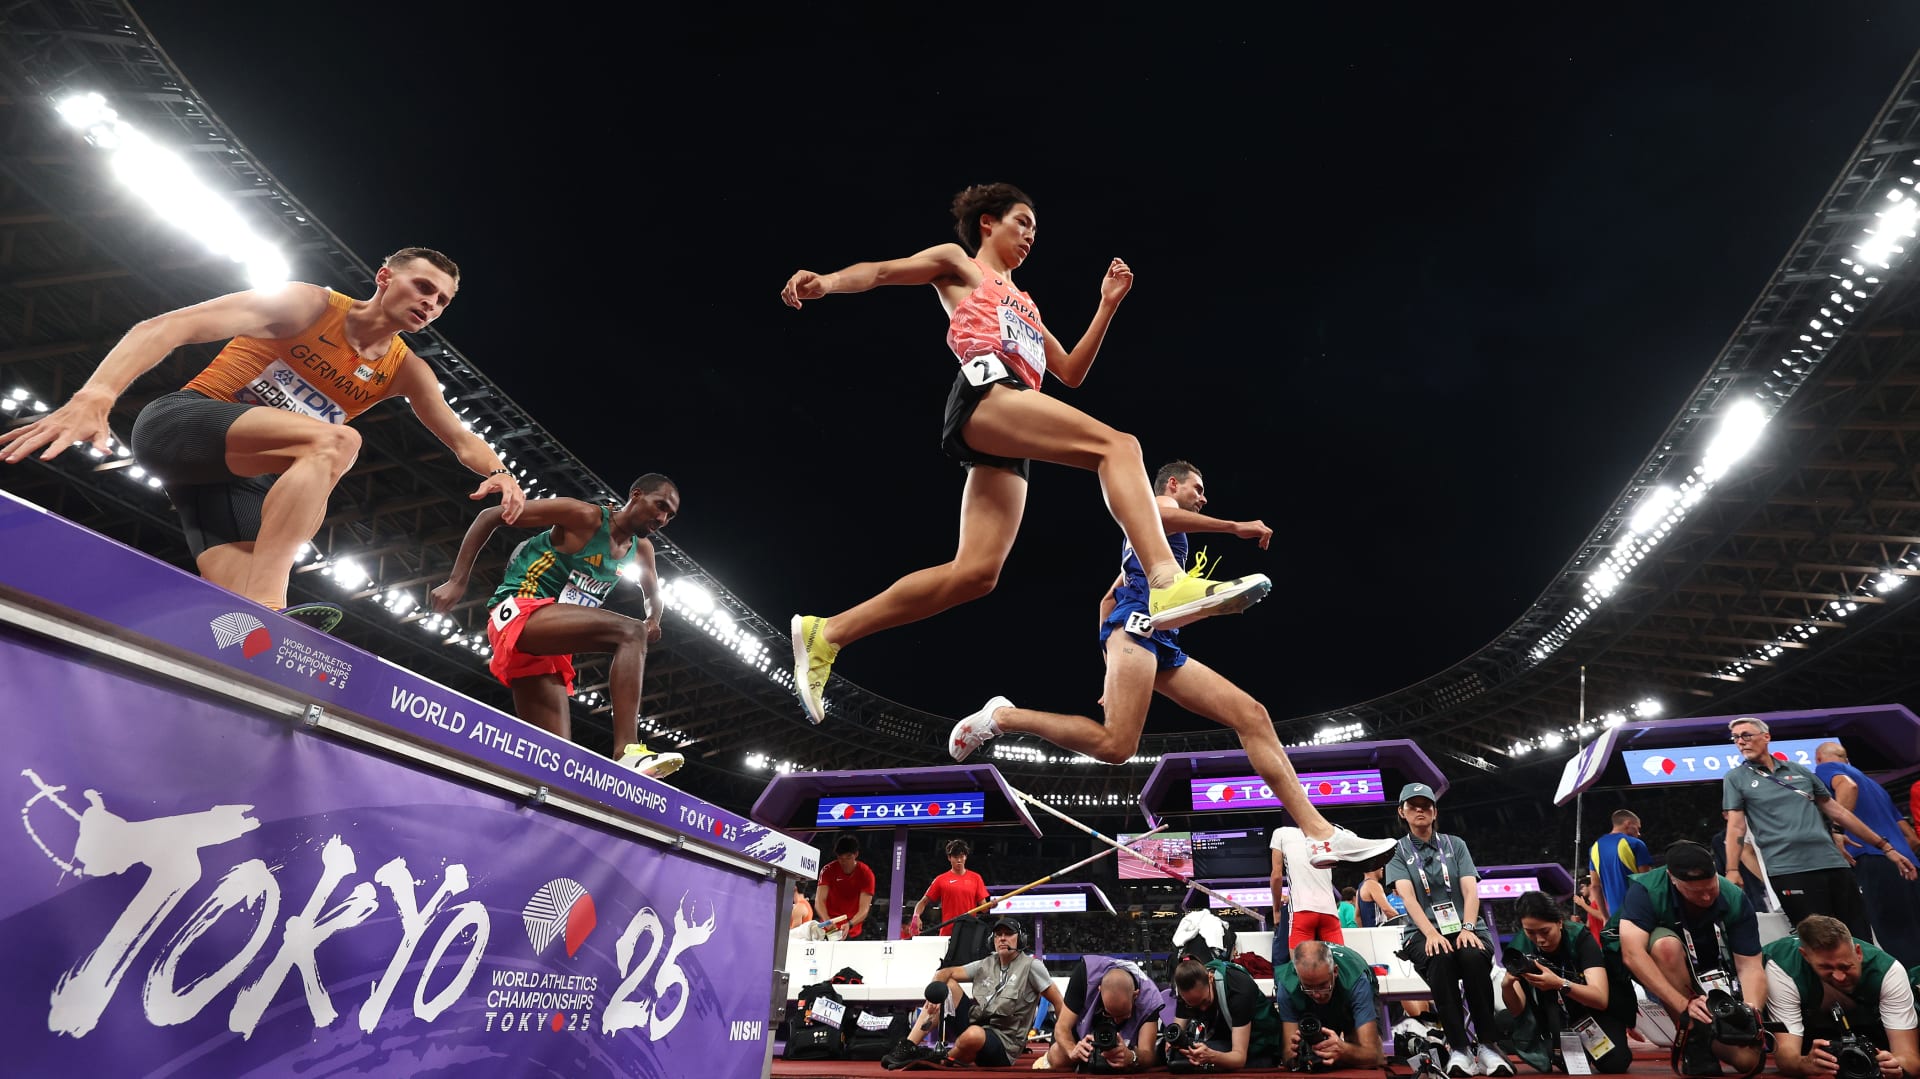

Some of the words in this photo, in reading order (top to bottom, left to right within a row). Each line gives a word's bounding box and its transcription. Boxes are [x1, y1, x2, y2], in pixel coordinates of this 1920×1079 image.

[1017, 319, 1044, 344] TDK
[290, 344, 376, 404] GERMANY
[973, 360, 997, 382] 2
[292, 378, 343, 425] TDK
[578, 592, 600, 608] TD
[500, 604, 512, 621] 6
[278, 646, 349, 680] CHAMPIONSHIPS
[283, 637, 311, 654] WORLD
[312, 651, 352, 672] ATHLETICS
[329, 677, 346, 689] 25
[390, 686, 466, 734] WORLD
[469, 721, 560, 772] ATHLETICS
[564, 758, 667, 814] CHAMPIONSHIPS
[723, 824, 737, 842] 25
[1340, 780, 1369, 795] 25
[947, 802, 972, 815] 25
[801, 856, 817, 872] NISHI
[20, 768, 491, 1040] TOKYO
[602, 890, 716, 1041] 25
[805, 948, 815, 956] 10
[884, 946, 893, 954] 11
[492, 970, 539, 988] WORLD
[540, 974, 597, 991] ATHLETICS
[487, 990, 594, 1010] CHAMPIONSHIPS
[824, 999, 843, 1013] TDK
[567, 1013, 591, 1031] 25
[824, 1010, 832, 1018] LI
[729, 1021, 762, 1041] NISHI
